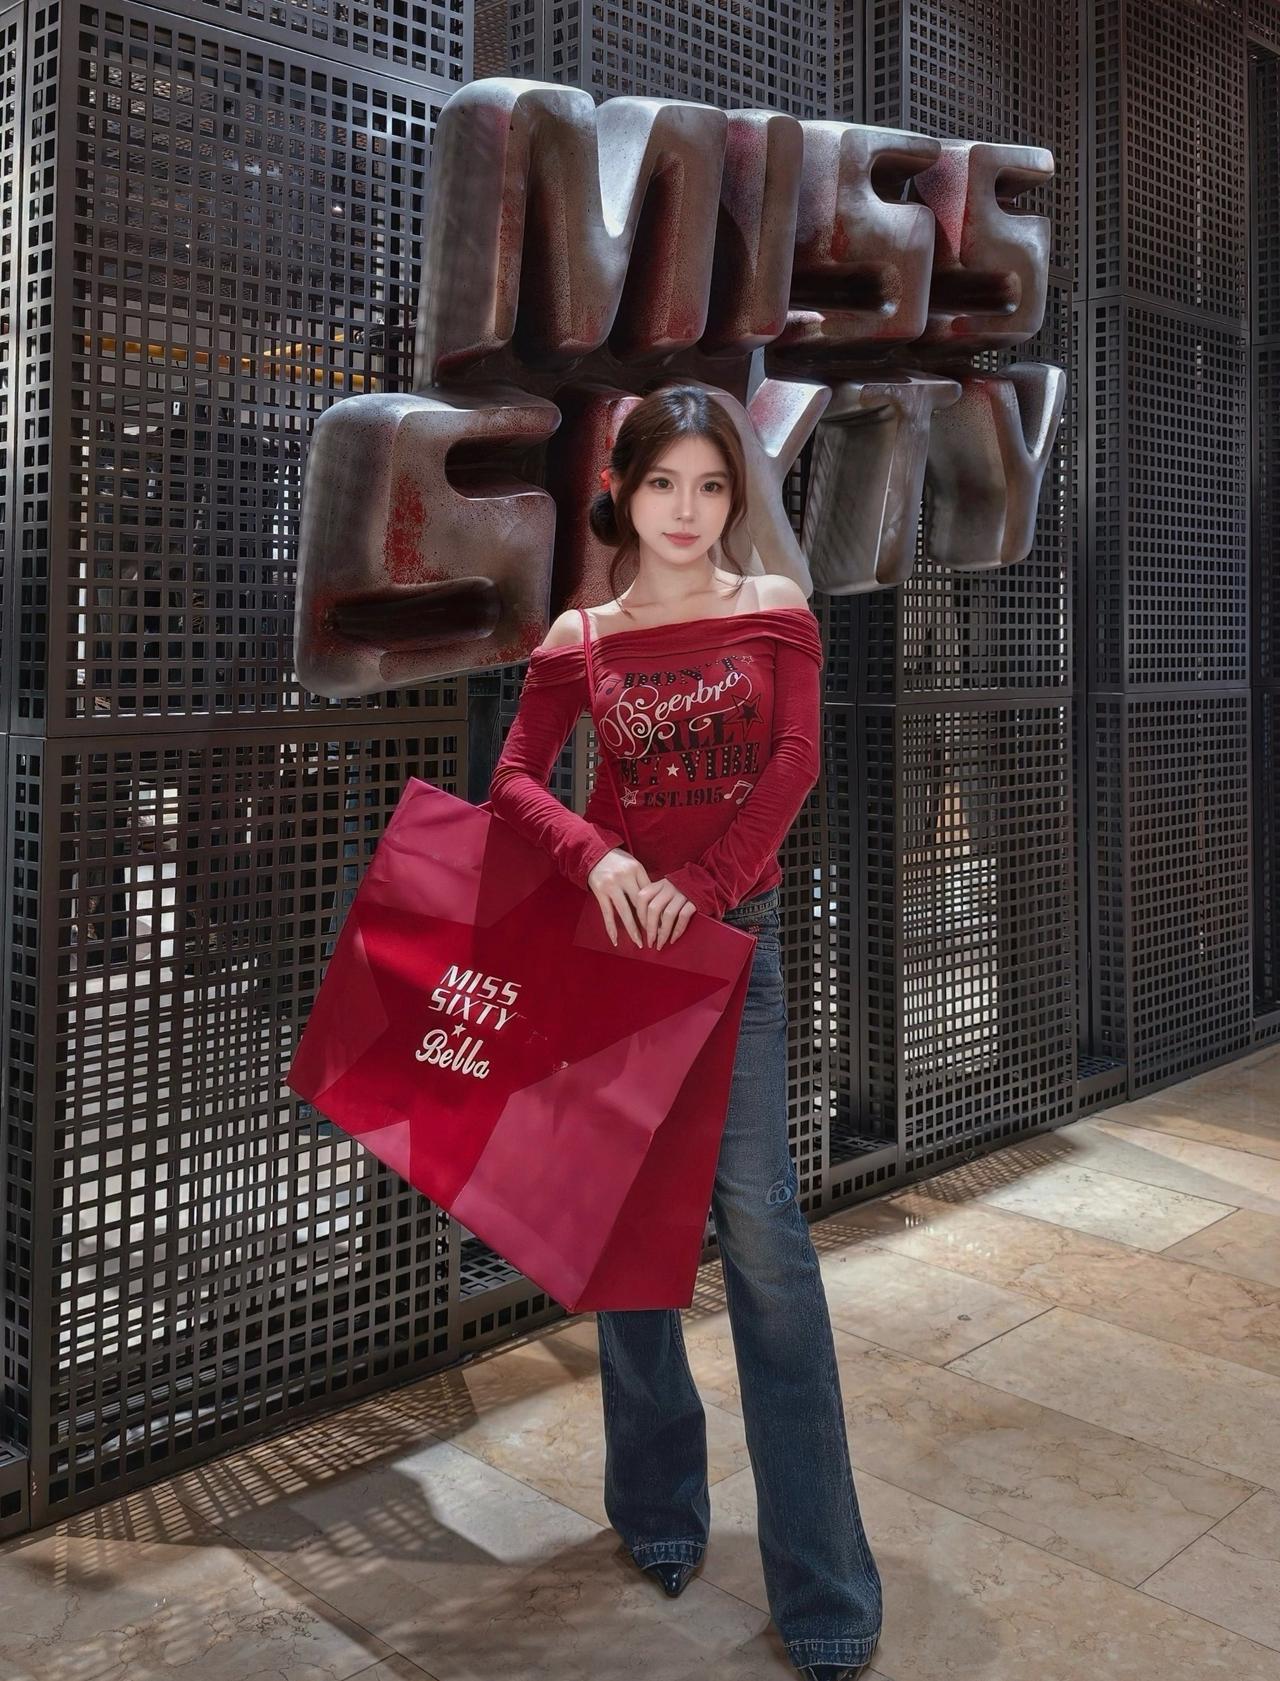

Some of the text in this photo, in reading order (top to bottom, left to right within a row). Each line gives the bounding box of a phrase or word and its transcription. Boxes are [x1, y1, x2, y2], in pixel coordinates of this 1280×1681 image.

[417, 77, 1057, 366] MISS
[680, 743, 760, 783] VIBE
[440, 965, 522, 1006] MISS
[428, 988, 518, 1031] SIXTY
[415, 1029, 490, 1079] Bella
